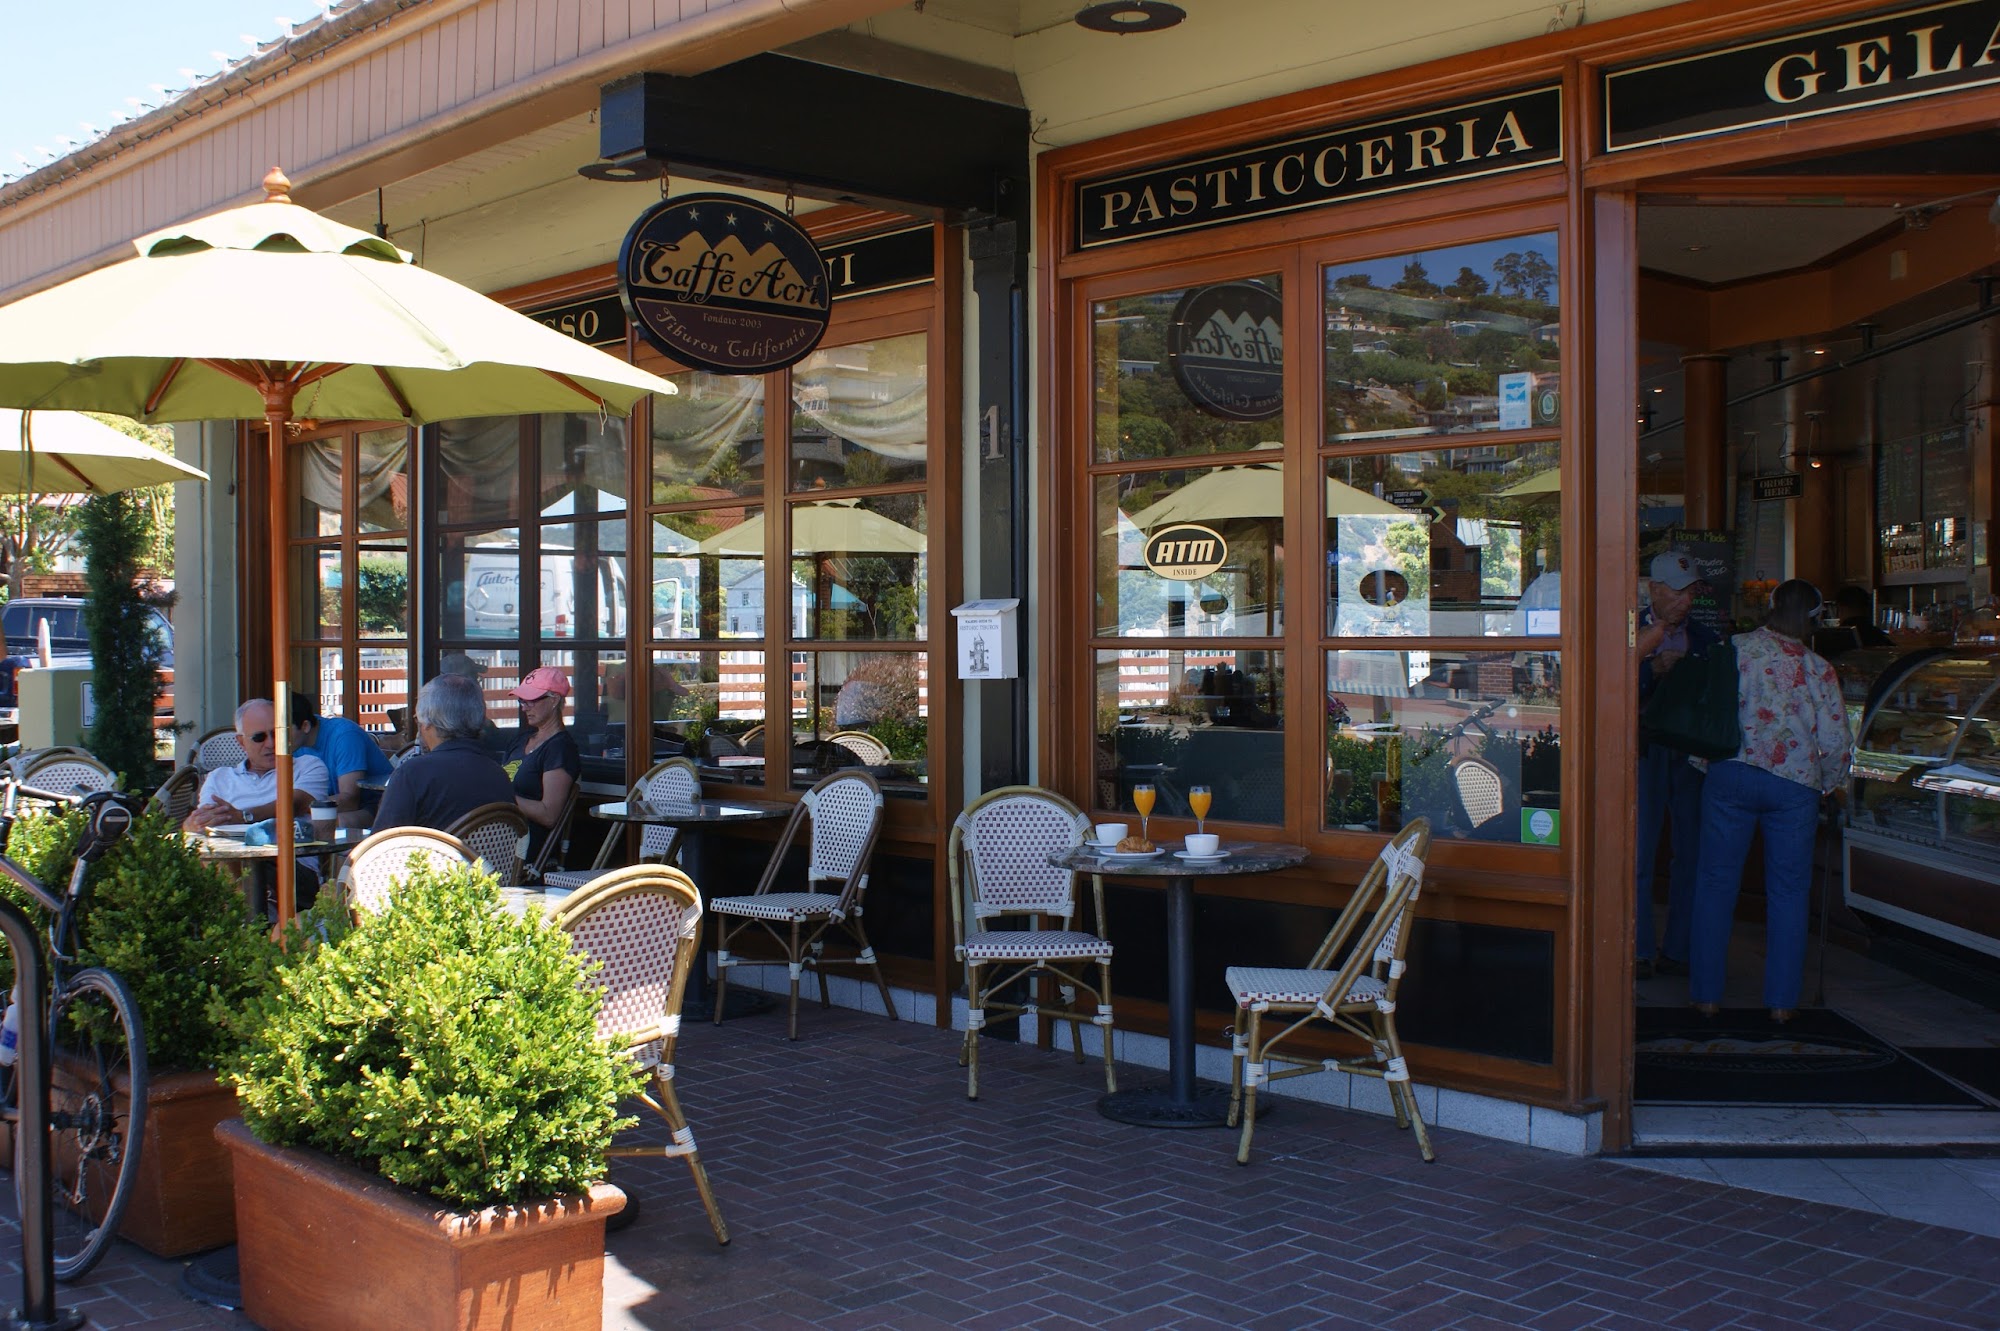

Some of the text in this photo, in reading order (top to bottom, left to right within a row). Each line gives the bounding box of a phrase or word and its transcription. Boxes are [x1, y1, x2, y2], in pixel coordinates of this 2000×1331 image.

[1099, 109, 1533, 231] PASTICCERIA
[738, 258, 822, 305] Acri
[703, 312, 763, 330] Fondato 2003
[656, 307, 807, 362] Tiburon California
[983, 405, 1005, 460] 1
[1759, 477, 1794, 488] ORDER
[1763, 486, 1793, 497] HERE
[1155, 539, 1216, 564] ATM
[1172, 568, 1198, 577] INSIDE
